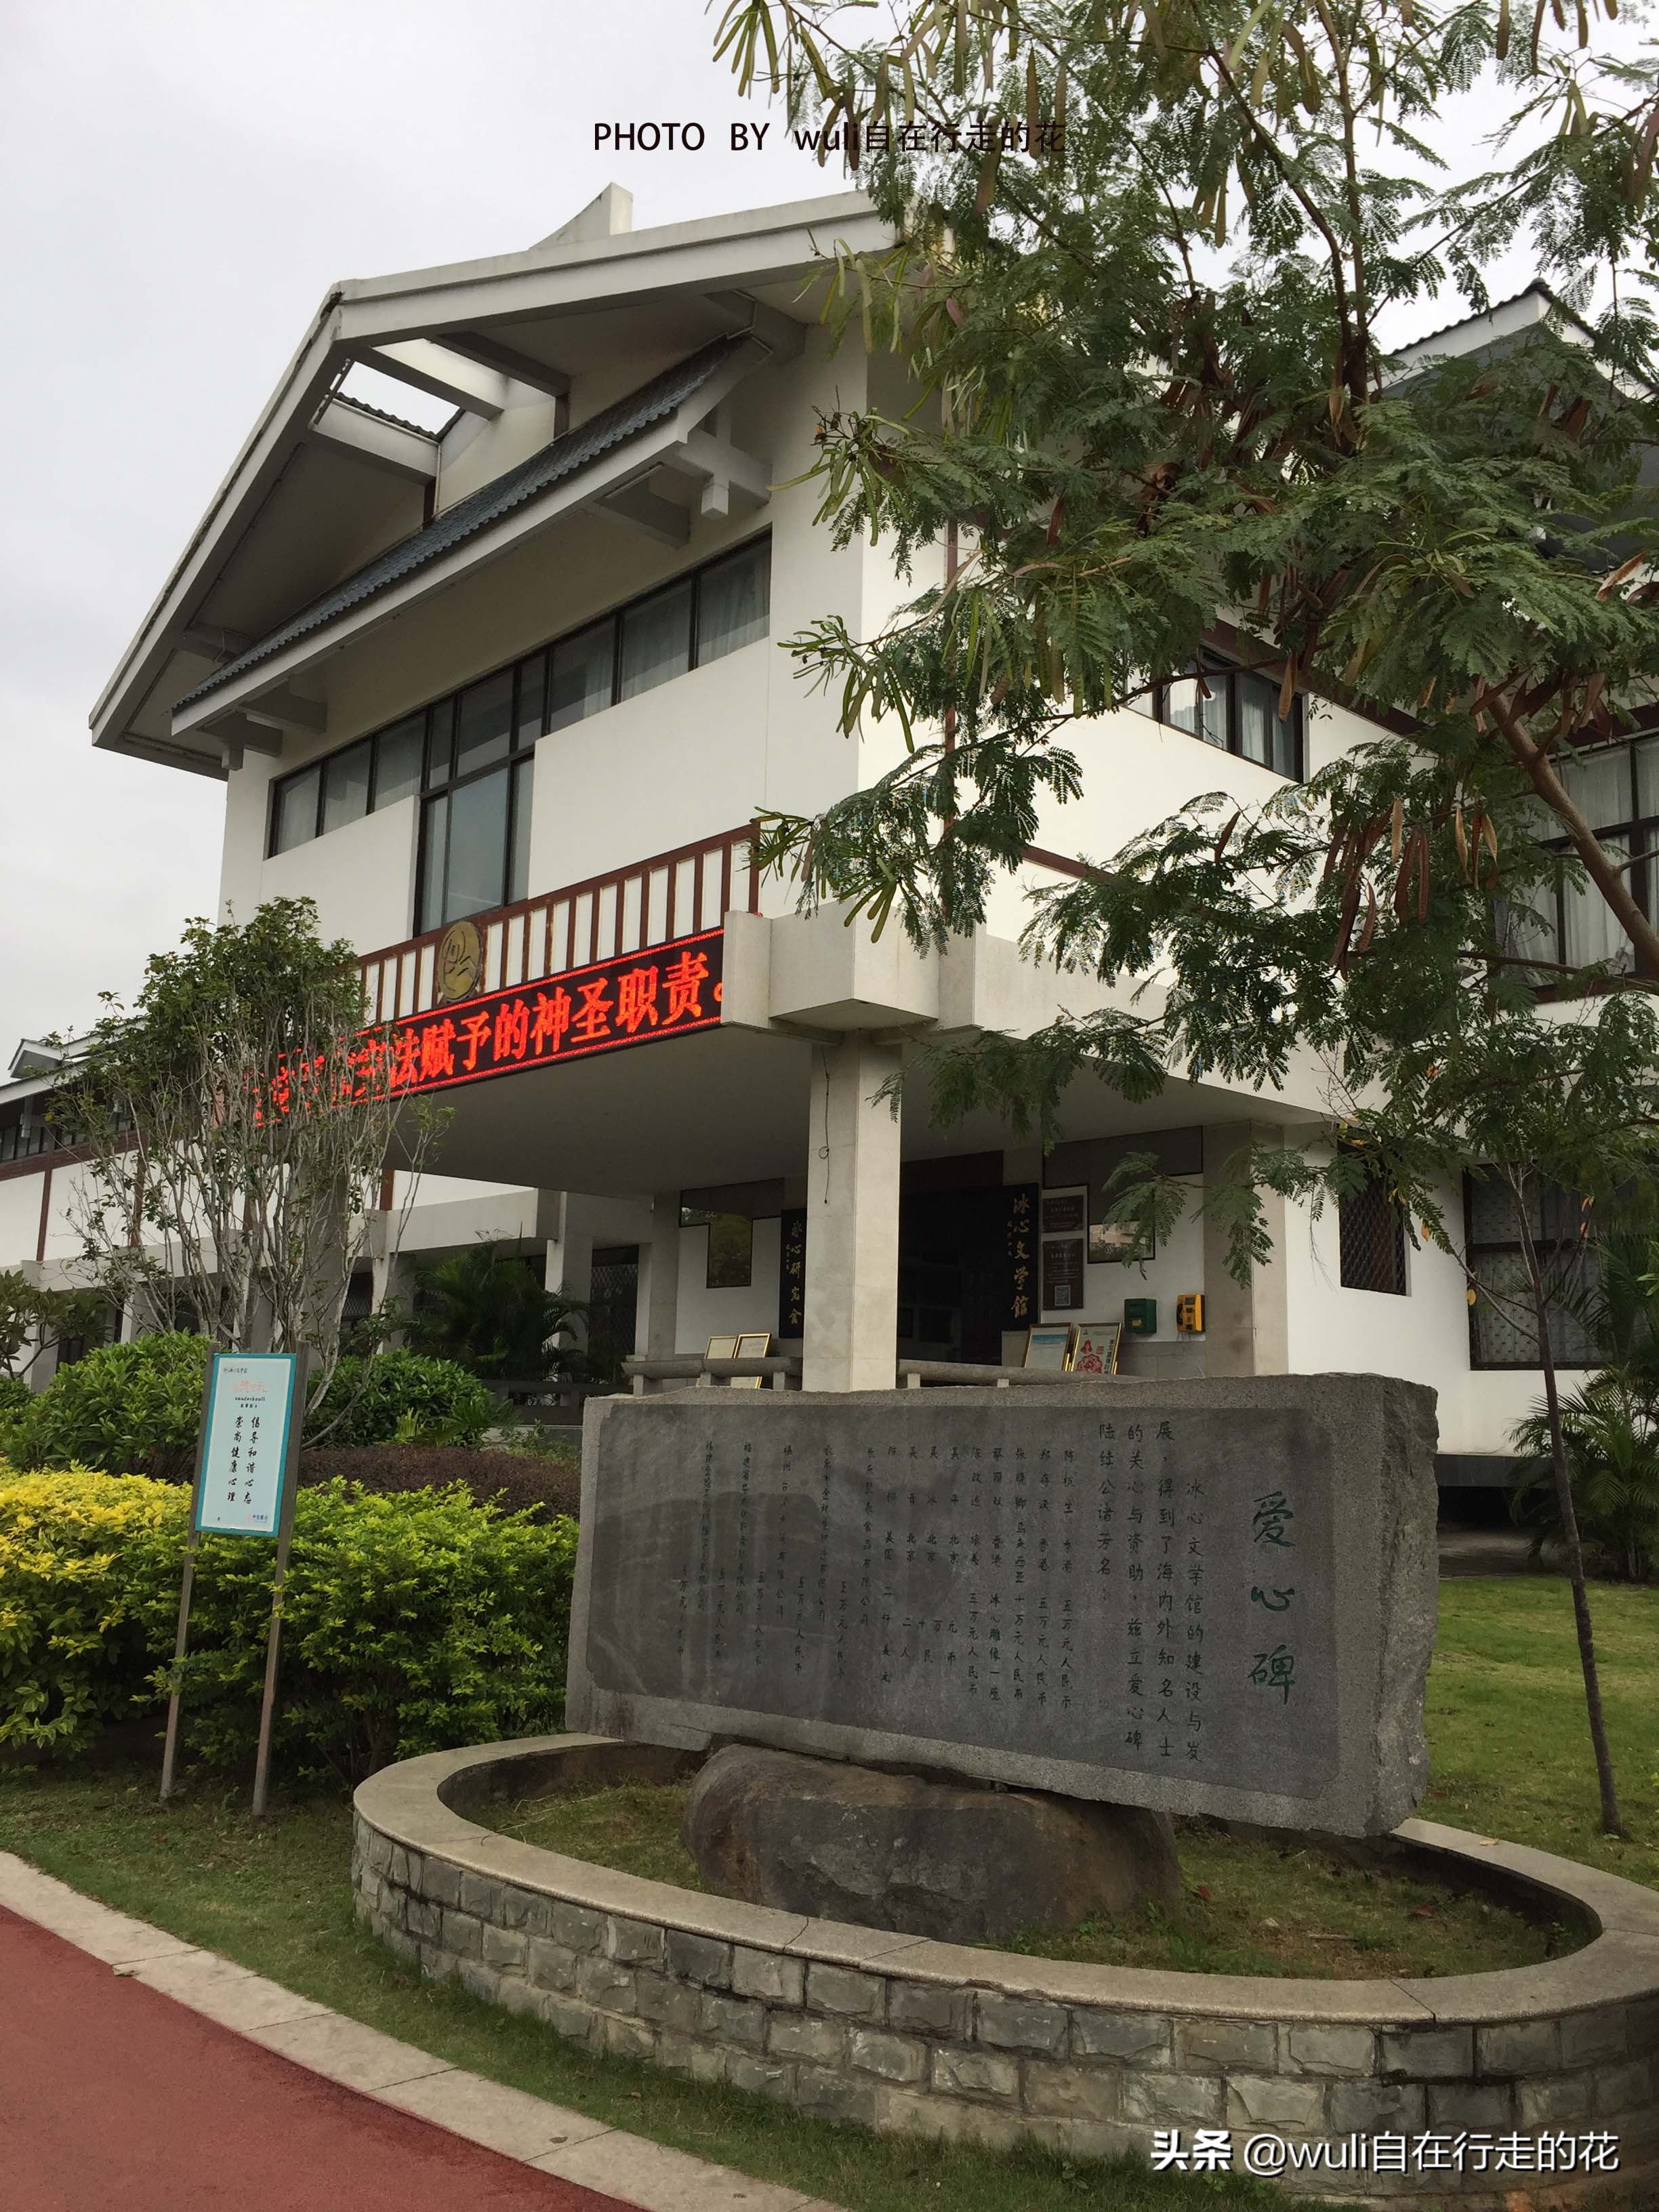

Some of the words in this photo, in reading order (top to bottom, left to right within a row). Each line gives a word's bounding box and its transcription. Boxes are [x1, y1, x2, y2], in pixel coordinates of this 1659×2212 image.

[227, 1415, 244, 1502] 崇尚健康心理
[243, 1416, 260, 1504] 倡导和谐心态
[1185, 1478, 1205, 1762] 冰心文学馆的建设与发
[1247, 1490, 1296, 1705] 爱心碑
